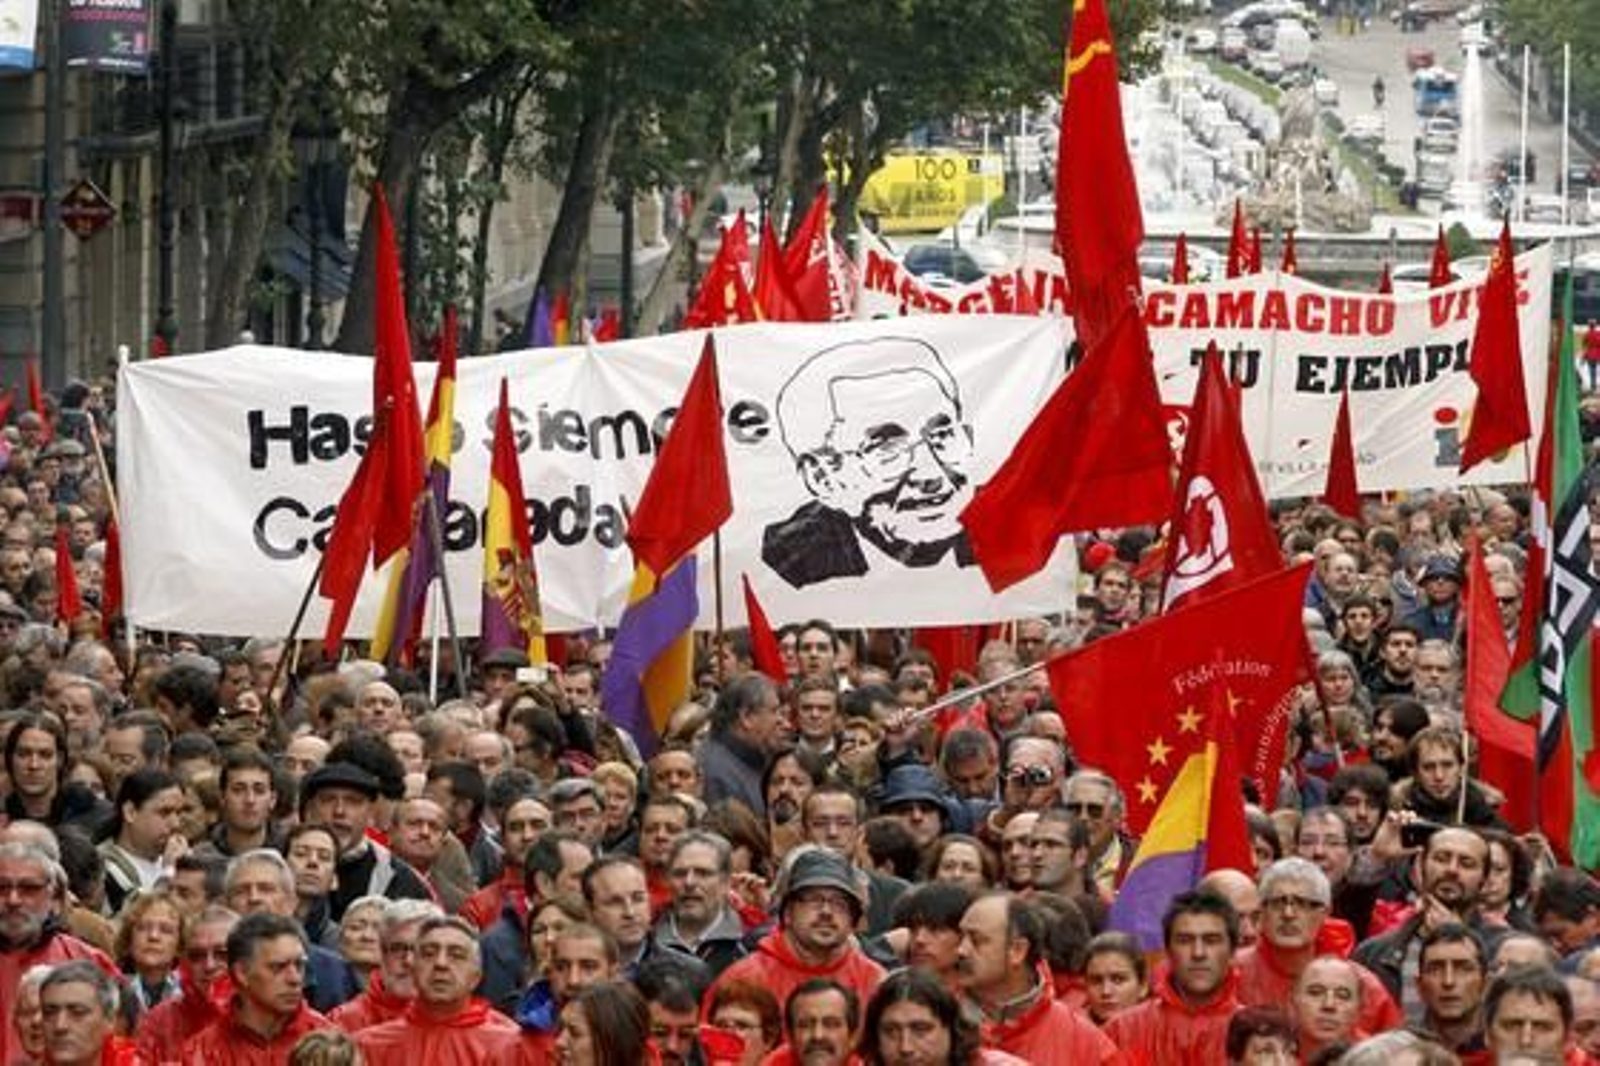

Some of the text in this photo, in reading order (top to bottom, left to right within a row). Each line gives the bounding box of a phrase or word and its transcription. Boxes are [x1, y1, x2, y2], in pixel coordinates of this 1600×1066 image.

[914, 158, 957, 181] 100
[1147, 291, 1396, 336] CAMACHO
[1190, 349, 1262, 388] TU
